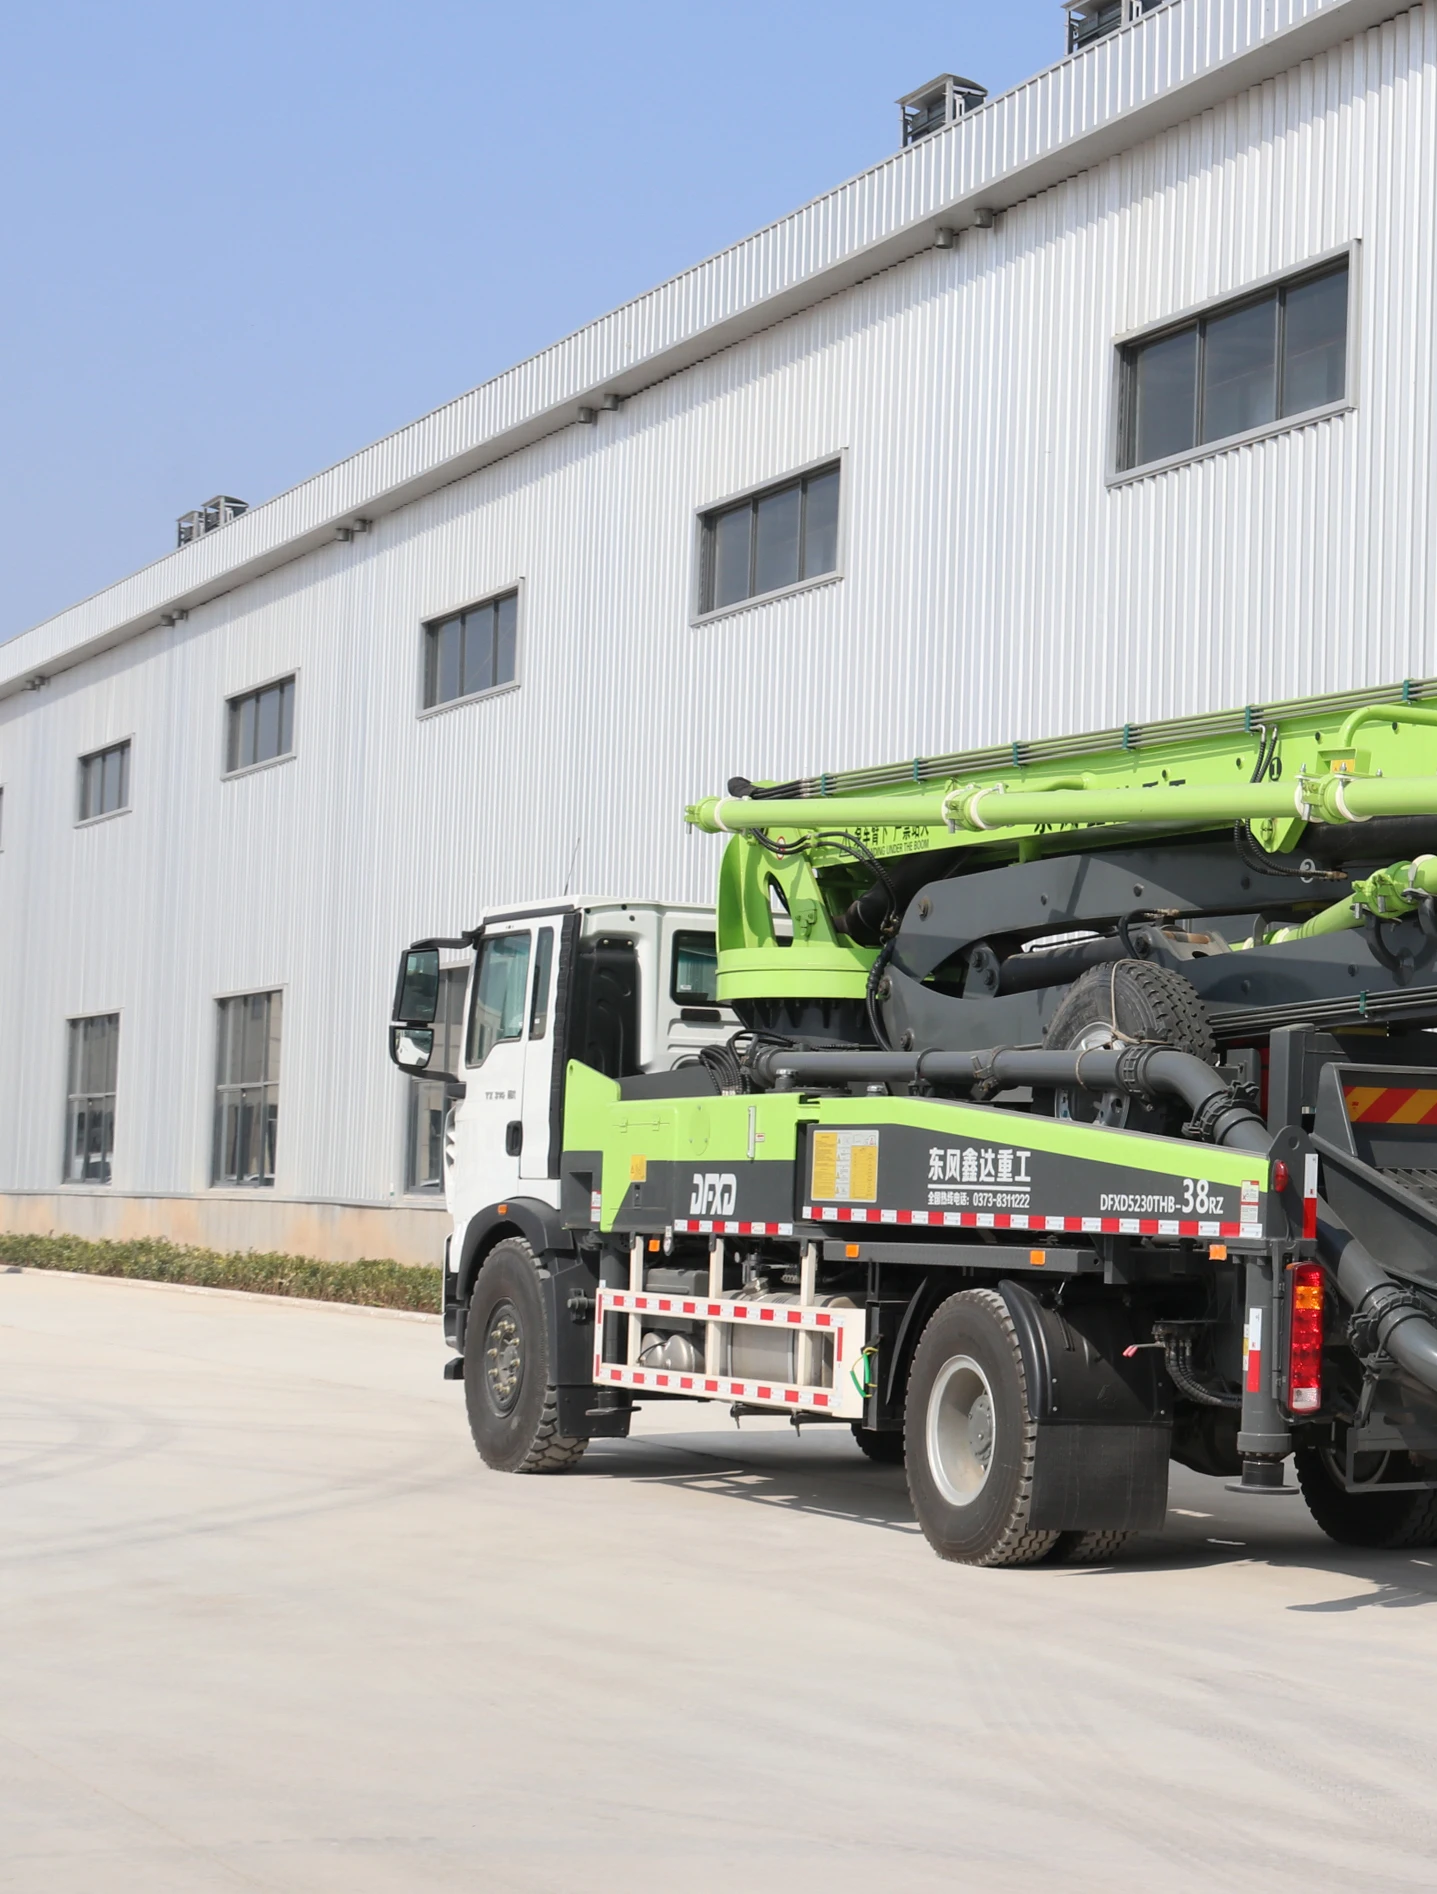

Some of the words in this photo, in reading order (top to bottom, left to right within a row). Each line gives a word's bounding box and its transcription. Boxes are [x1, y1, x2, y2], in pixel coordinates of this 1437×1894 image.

[886, 843, 903, 854] UNDER
[904, 841, 913, 852] THE
[914, 839, 930, 850] BOOM
[928, 1147, 1031, 1182] 东风鑫达重工
